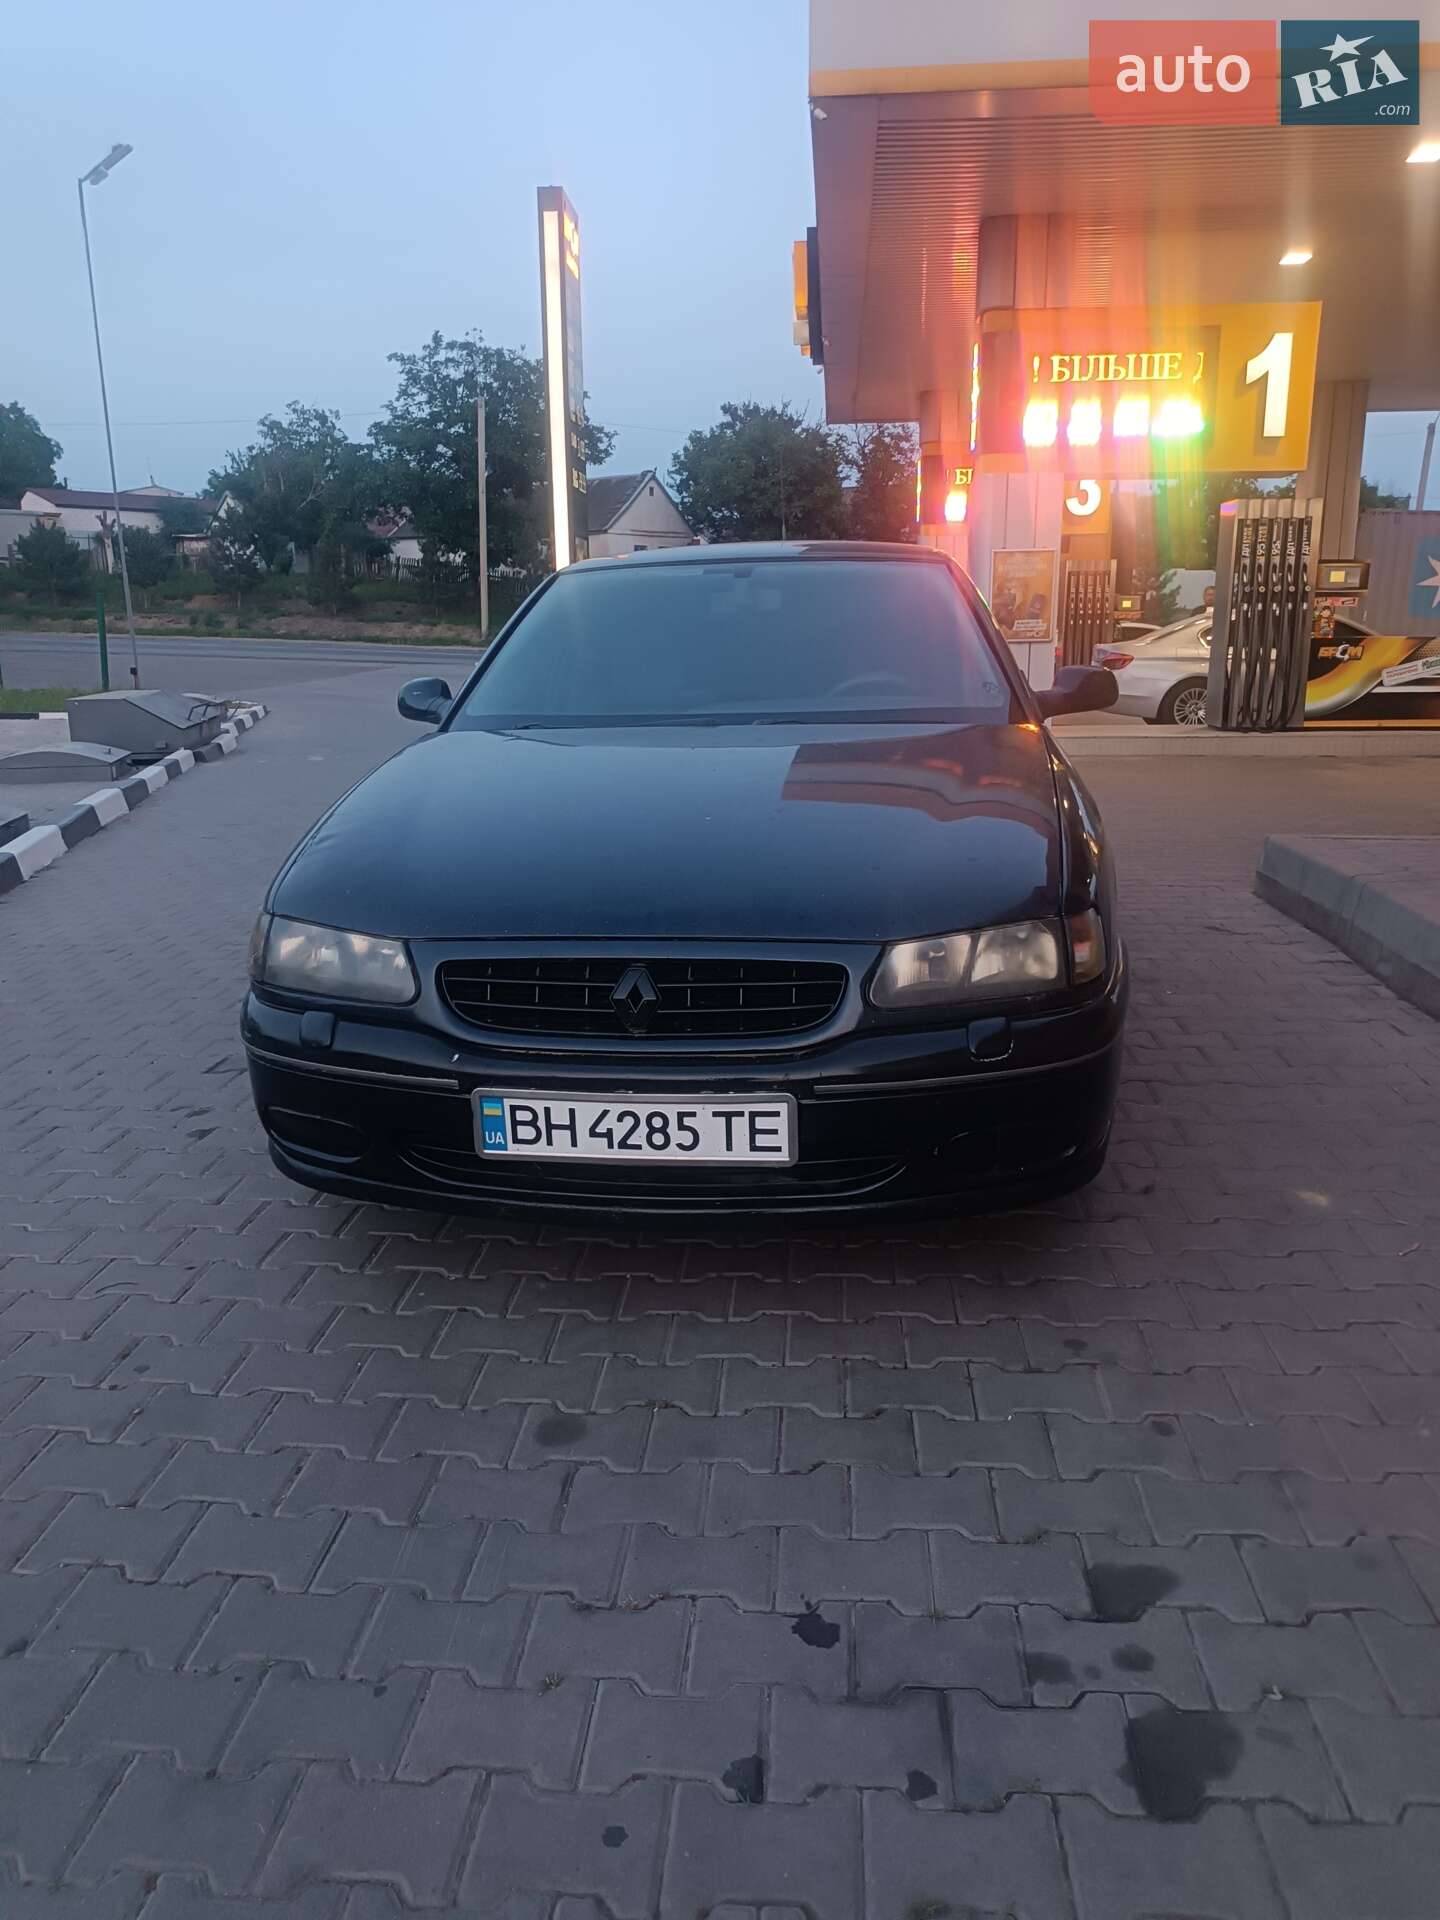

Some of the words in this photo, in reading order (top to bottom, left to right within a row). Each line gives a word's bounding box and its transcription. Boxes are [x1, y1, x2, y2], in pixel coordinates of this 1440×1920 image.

[1050, 352, 1184, 383] БІЛЬШЕ
[1245, 332, 1294, 437] 1
[485, 1131, 505, 1145] UA
[509, 1104, 578, 1148] BH
[588, 1108, 700, 1152] 4285
[711, 1110, 782, 1153] TE
